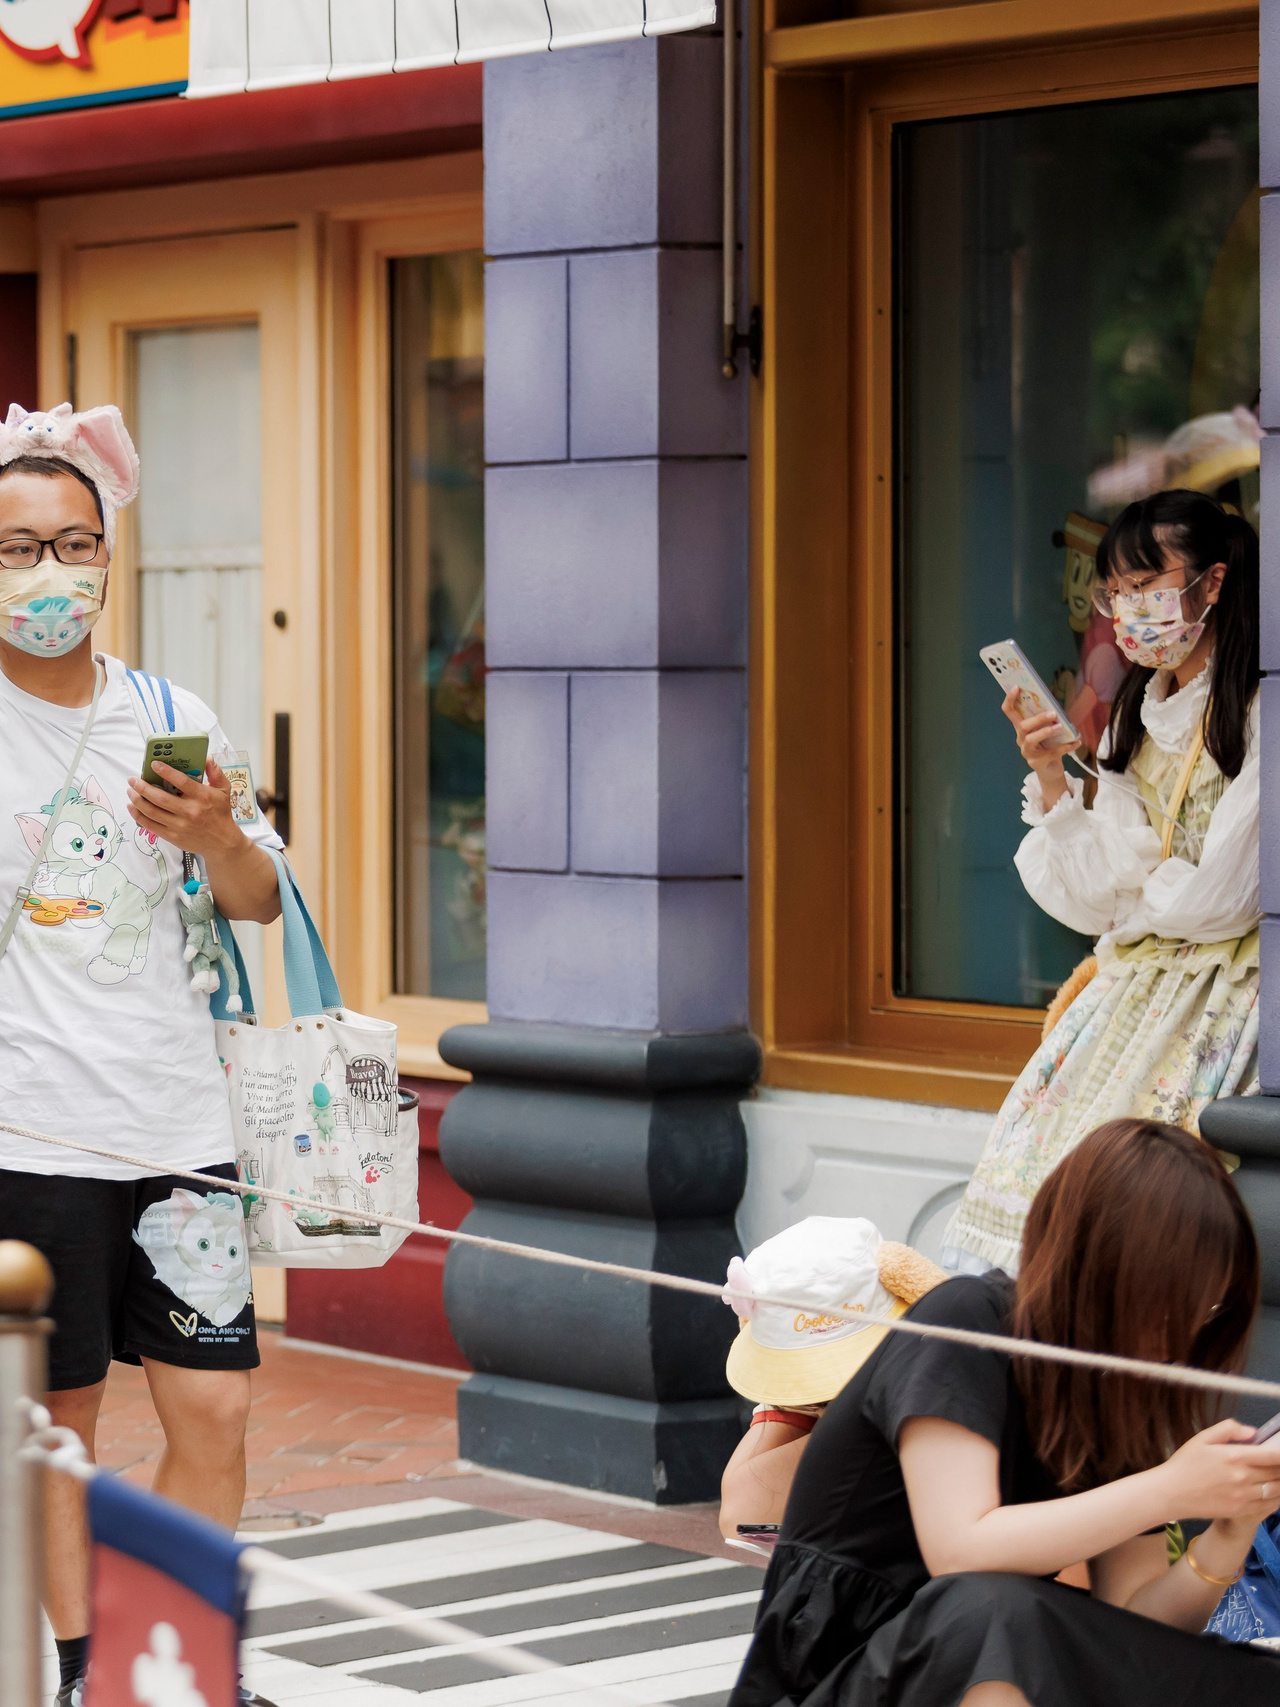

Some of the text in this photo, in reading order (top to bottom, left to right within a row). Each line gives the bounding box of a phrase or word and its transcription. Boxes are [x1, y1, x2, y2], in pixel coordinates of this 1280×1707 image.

[349, 1066, 379, 1079] Bravo!
[245, 1081, 256, 1089] un
[247, 1092, 264, 1102] Vive
[265, 1094, 273, 1102] in
[243, 1102, 256, 1113] del
[244, 1114, 257, 1128] Gli
[279, 1110, 295, 1123] olto
[197, 1326, 217, 1335] ONE
[218, 1327, 235, 1335] AND
